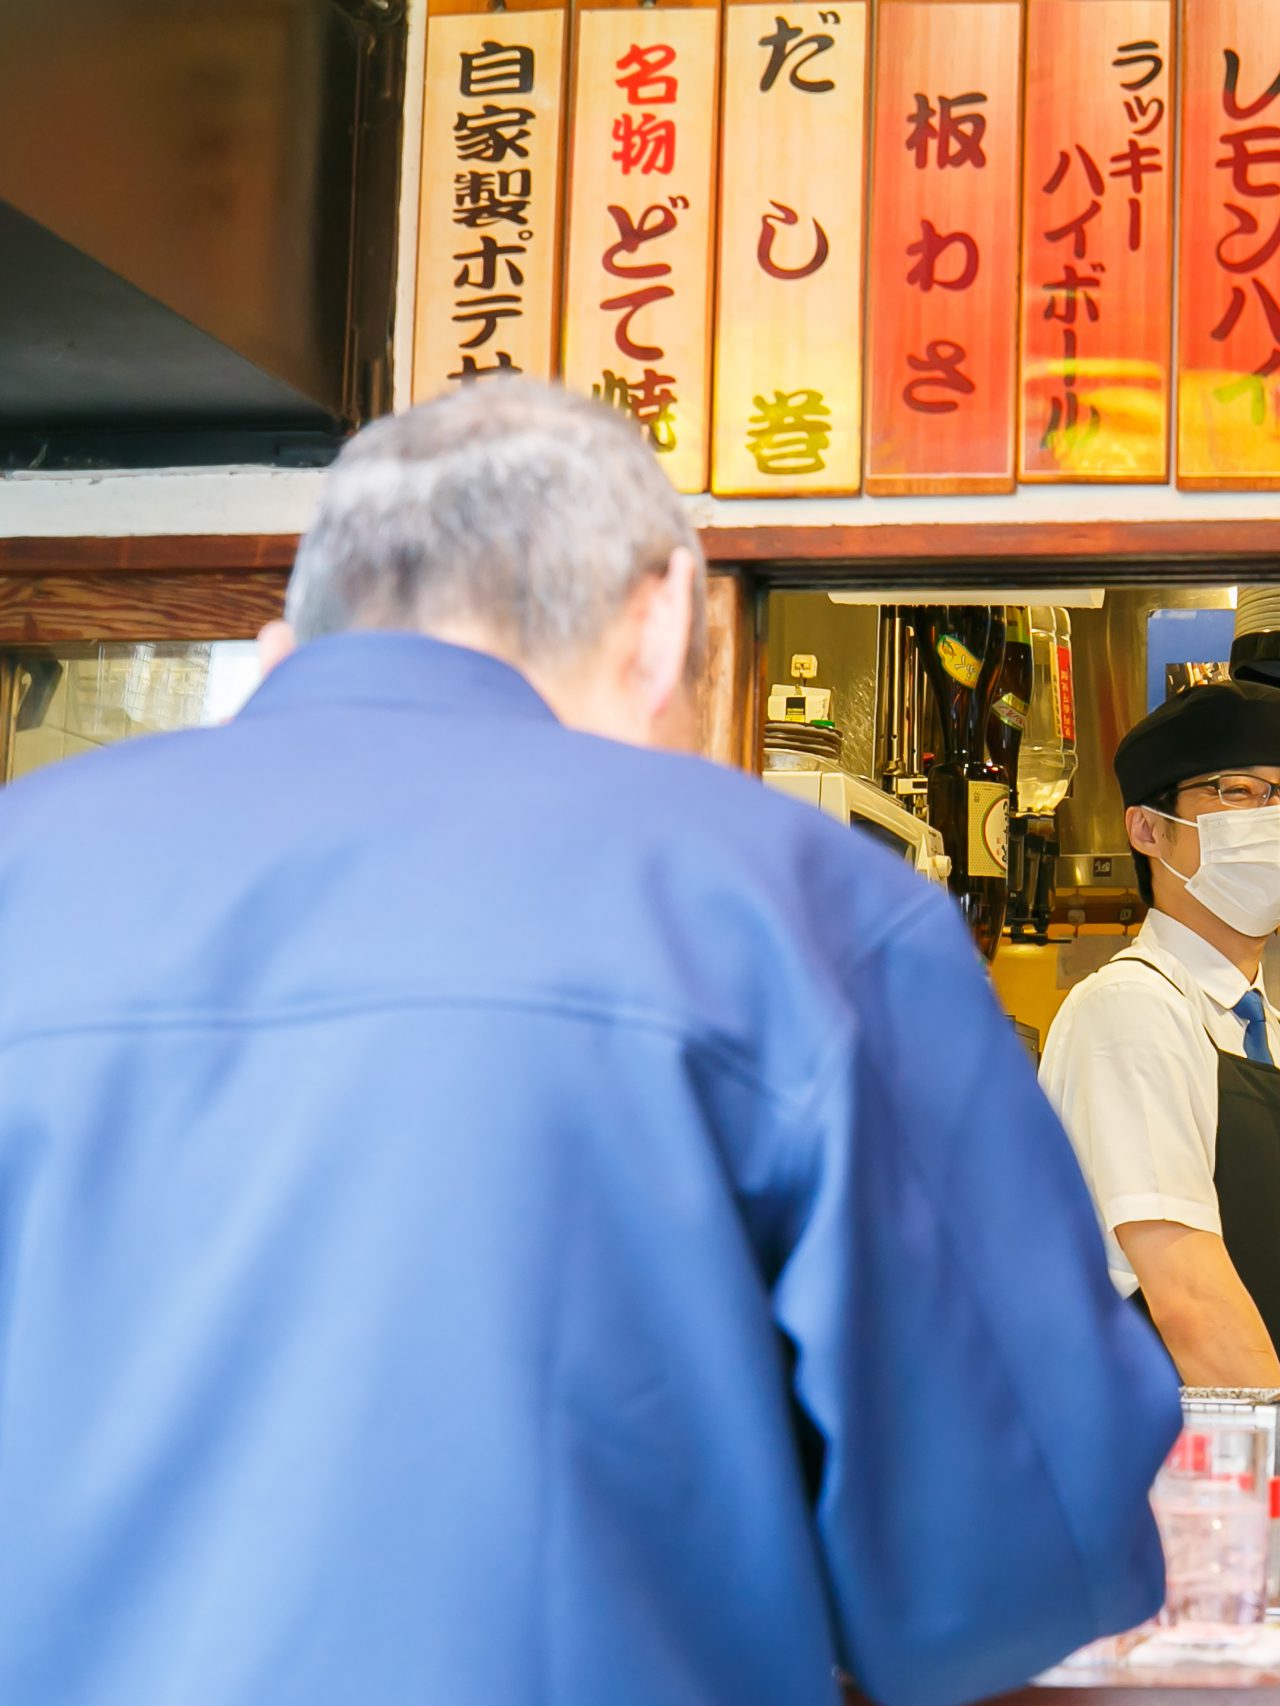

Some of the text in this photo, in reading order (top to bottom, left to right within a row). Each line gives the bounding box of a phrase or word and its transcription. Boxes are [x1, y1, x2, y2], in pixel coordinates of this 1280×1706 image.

[745, 11, 840, 475] だし巻
[903, 92, 988, 414] 板わさ
[1040, 143, 1106, 450] ハイボール
[1109, 40, 1164, 252] ラッキー
